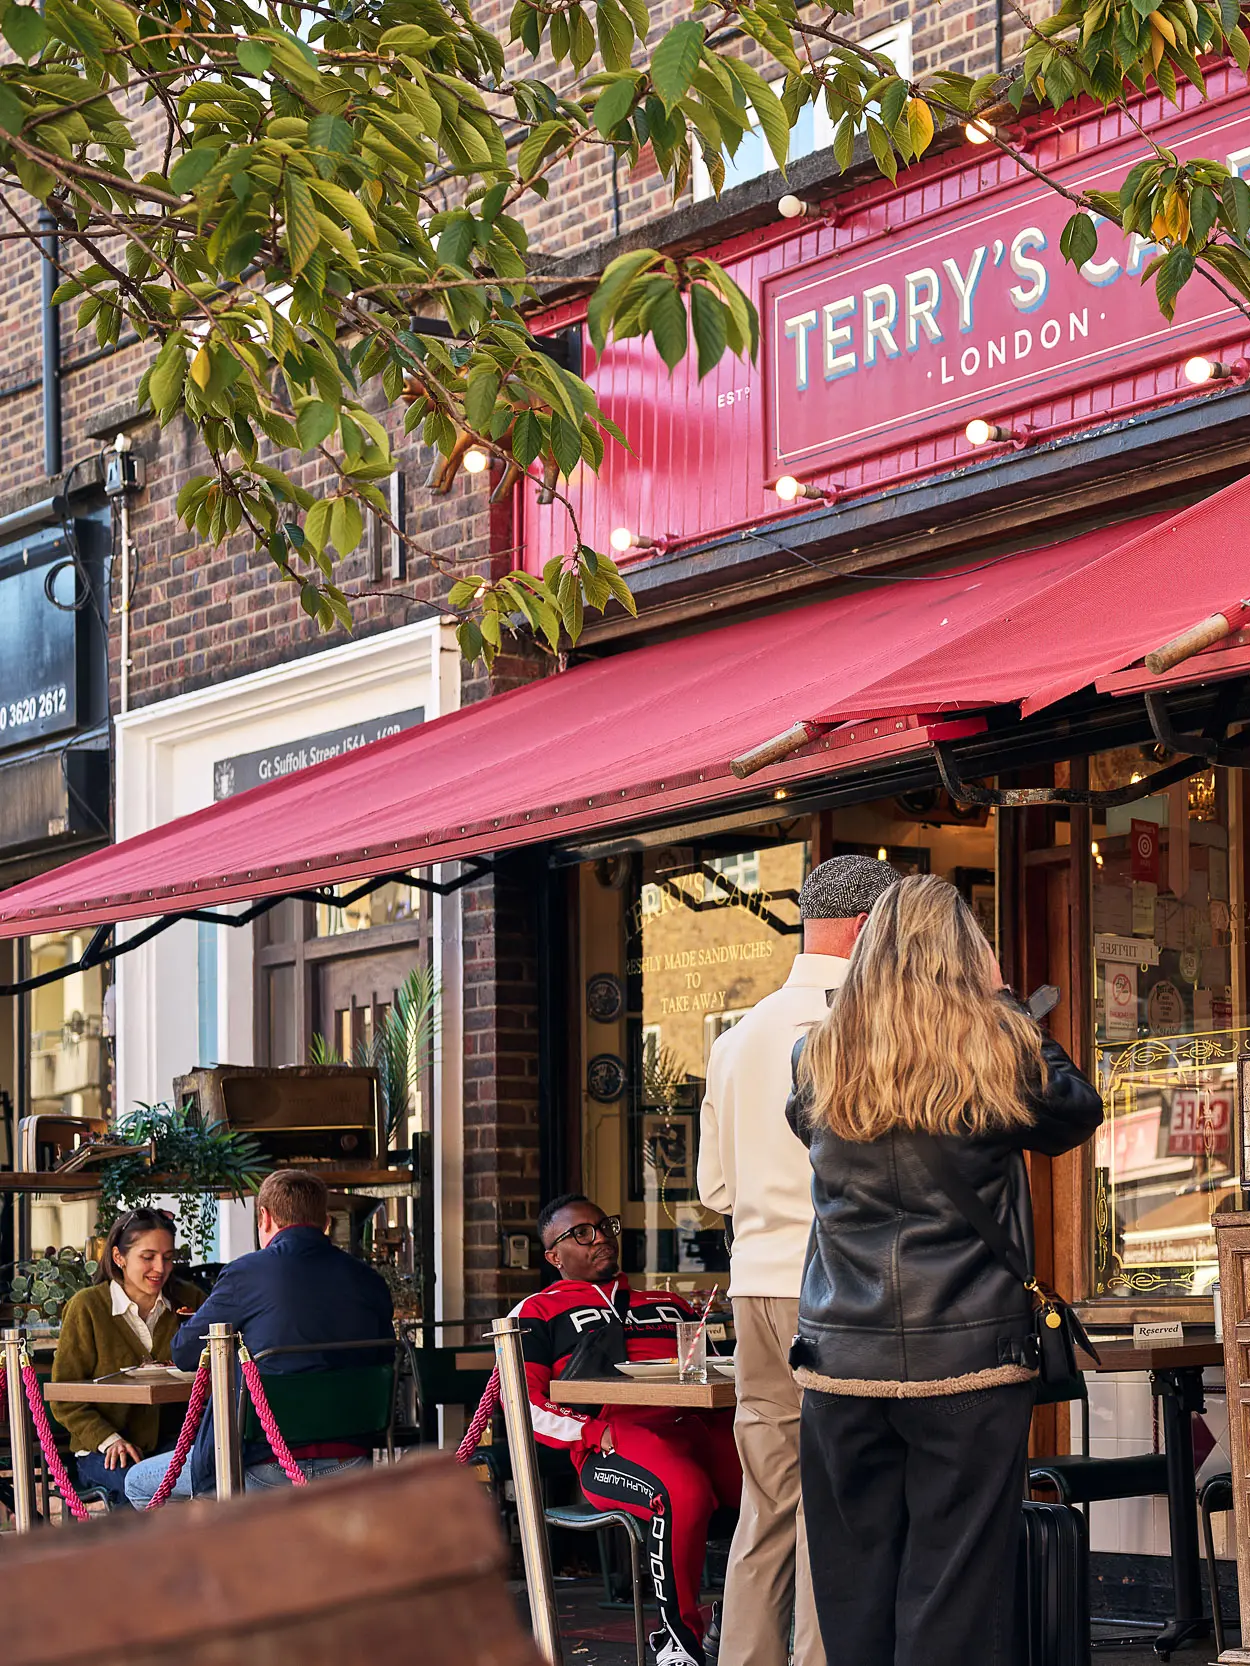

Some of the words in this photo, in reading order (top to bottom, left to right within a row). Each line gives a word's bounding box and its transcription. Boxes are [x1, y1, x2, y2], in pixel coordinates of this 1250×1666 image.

[784, 226, 1048, 391] TERRY'S
[940, 308, 1089, 384] LONDON
[9, 697, 36, 727] 3620
[38, 688, 66, 718] 2612
[258, 760, 272, 779] Gt
[274, 750, 308, 777] Suffolk
[310, 744, 341, 766] Street
[342, 733, 366, 756] 156A
[625, 872, 705, 945] TERRY'S
[626, 954, 661, 976] RESHLY
[664, 950, 697, 971] MADE
[698, 940, 773, 966] SANDWICHES
[685, 972, 701, 989] TO
[661, 995, 690, 1014] TAKE
[692, 991, 726, 1011] AWAY
[636, 1323, 677, 1331] LAURE
[1139, 1324, 1180, 1336] Reserved
[593, 1471, 626, 1489] LAUREN
[626, 1482, 654, 1499] RALPH
[650, 1516, 667, 1602] POLO
